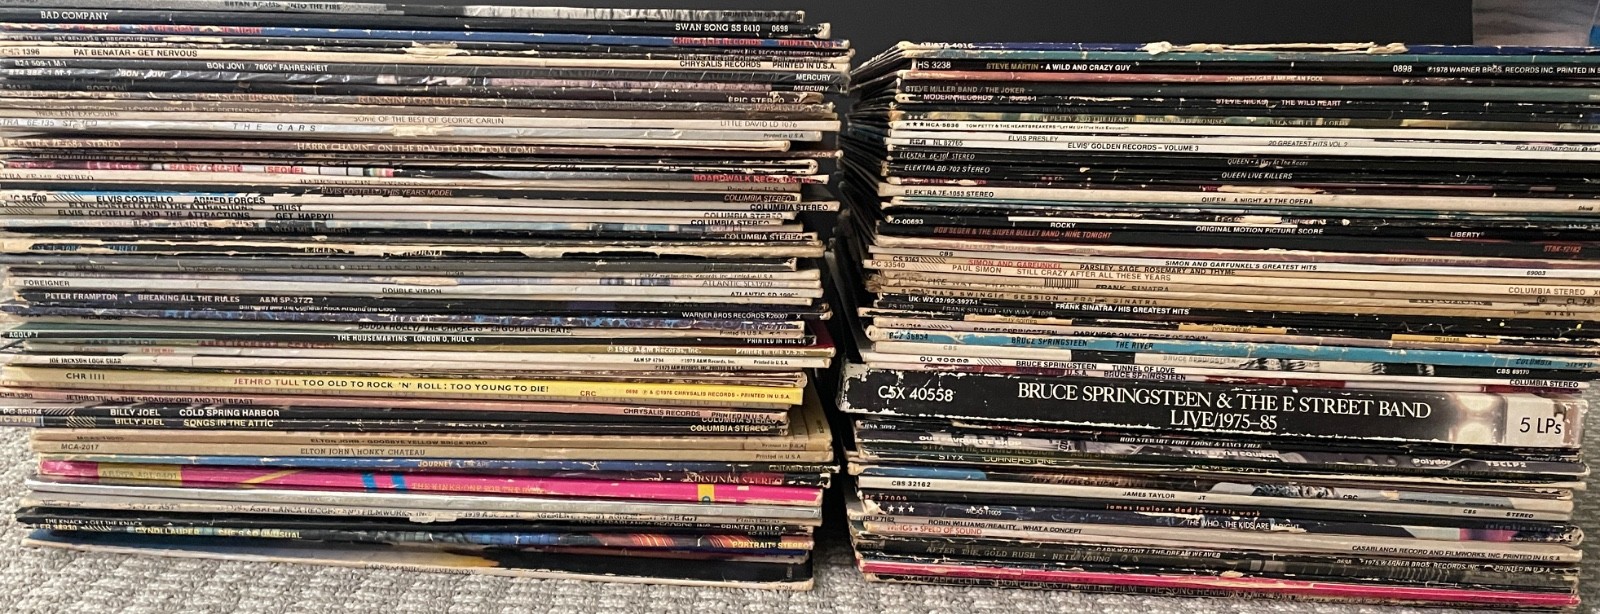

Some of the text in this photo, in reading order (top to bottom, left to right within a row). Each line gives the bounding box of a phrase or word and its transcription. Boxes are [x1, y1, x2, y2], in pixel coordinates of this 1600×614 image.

[40, 11, 108, 20] BAD COMPANY
[704, 24, 728, 32] SONG
[732, 24, 742, 32] SS
[744, 24, 760, 32] 8410
[22, 48, 40, 56] 1396
[157, 50, 198, 58] NERVOUS
[206, 62, 244, 70] BON JOVI
[279, 64, 328, 72] FAHRENHEIT
[680, 60, 722, 68] CHRYSALIS
[772, 62, 800, 70] PRINTED
[932, 61, 952, 69] 3238
[986, 62, 1009, 70] STEVE
[1115, 64, 1131, 72] GUY
[796, 74, 831, 82] MERCURY
[986, 86, 998, 94] THE
[744, 120, 767, 128] DAVID
[1164, 144, 1193, 152] VOLUME
[694, 174, 750, 182] BOARDWALK
[1264, 172, 1292, 180] KILLERS
[724, 194, 762, 202] COLUMBIA
[188, 212, 250, 220] ATTRACTIONS
[1233, 226, 1263, 234] MOTION
[975, 266, 1002, 274] SIMON
[1070, 270, 1096, 278] AFTER
[1117, 272, 1142, 280] THESE
[1145, 273, 1171, 281] YEARS
[1508, 286, 1586, 296] COLUMBIA STEREO
[138, 294, 178, 302] BREAKING
[1133, 306, 1170, 314] GREATEST
[1038, 338, 1132, 348] SPRINGSTEEN THE
[1016, 360, 1042, 368] BRUCE
[1044, 361, 1097, 370] SPRINGSTEEN
[1156, 366, 1176, 374] LOVE
[275, 378, 300, 386] TULL
[366, 380, 393, 388] ROCK
[1550, 380, 1579, 388] STEREO
[878, 384, 954, 402] C5X 40558
[1017, 383, 1432, 418] BRUCE SPRINGSTEEN & THE E STREET BAND
[624, 408, 664, 416] CHRYSALIS
[141, 418, 164, 426] JOEL
[248, 419, 274, 427] ATTIC
[1520, 417, 1562, 434] 5 LPs
[691, 424, 732, 432] COLUMBIA
[1413, 458, 1451, 466] Polydor
[1122, 490, 1146, 498] JAMES
[1050, 526, 1082, 534] CONCEPT
